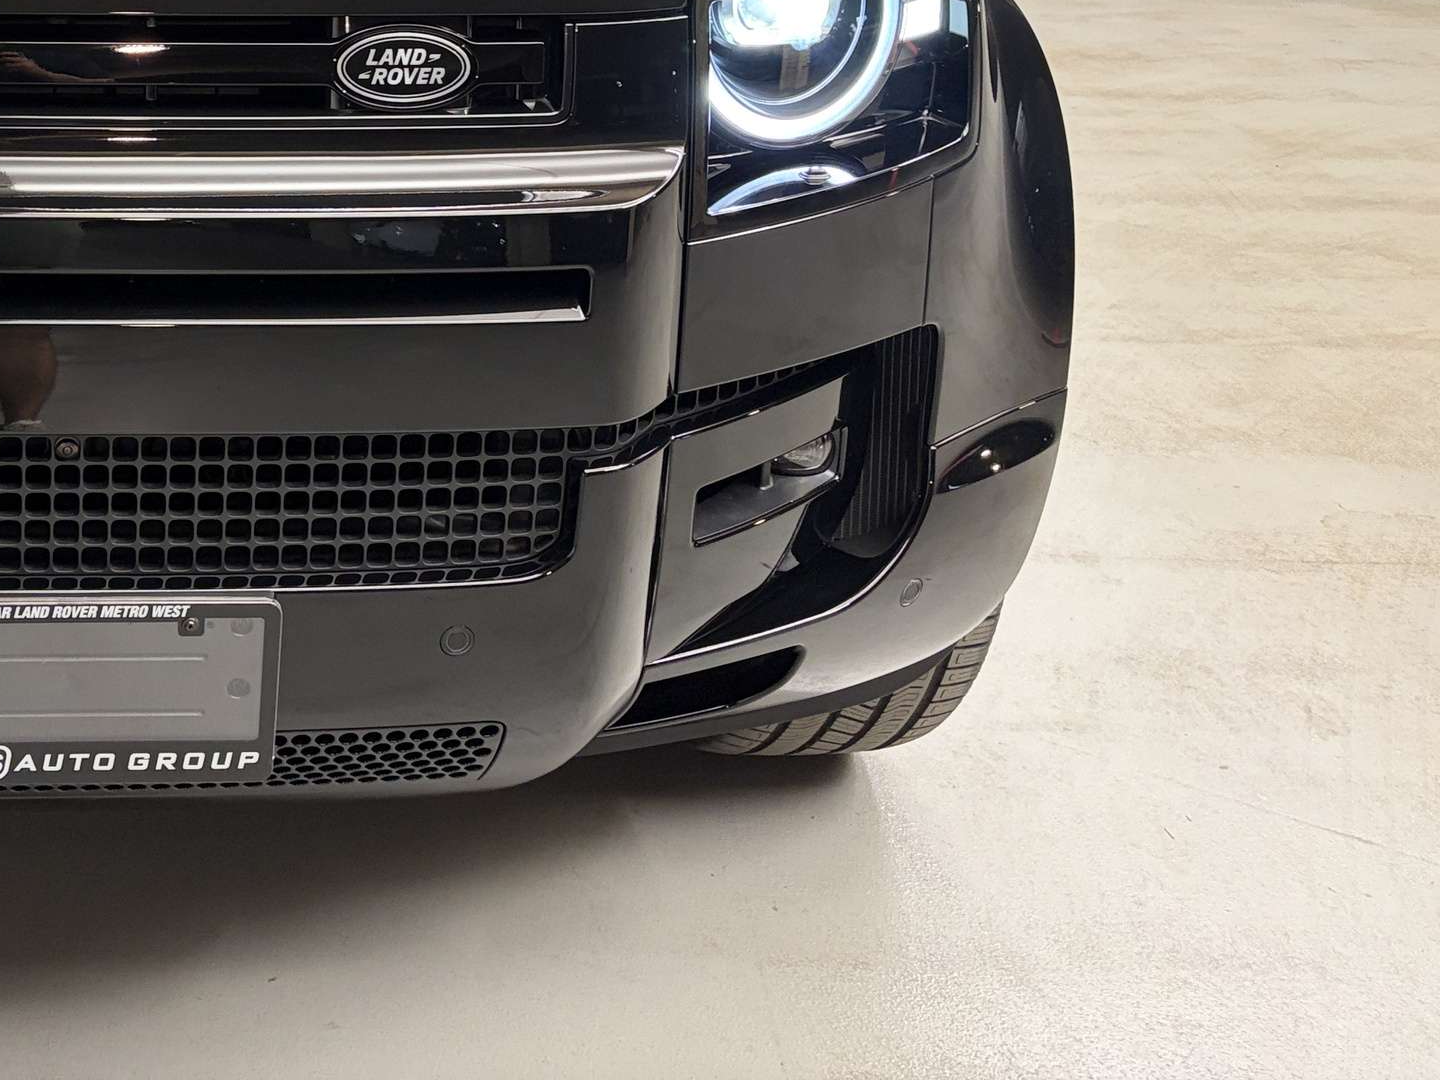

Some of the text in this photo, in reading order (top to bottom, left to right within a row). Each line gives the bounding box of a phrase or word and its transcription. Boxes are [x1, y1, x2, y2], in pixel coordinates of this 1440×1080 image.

[366, 48, 427, 66] LAND
[371, 67, 446, 85] ROVER
[13, 605, 50, 619] LAND
[53, 605, 98, 619] ROVER
[100, 604, 149, 618] METRO
[151, 604, 191, 618] WEST
[13, 752, 116, 772] AUTO
[127, 751, 260, 771] GROUP
